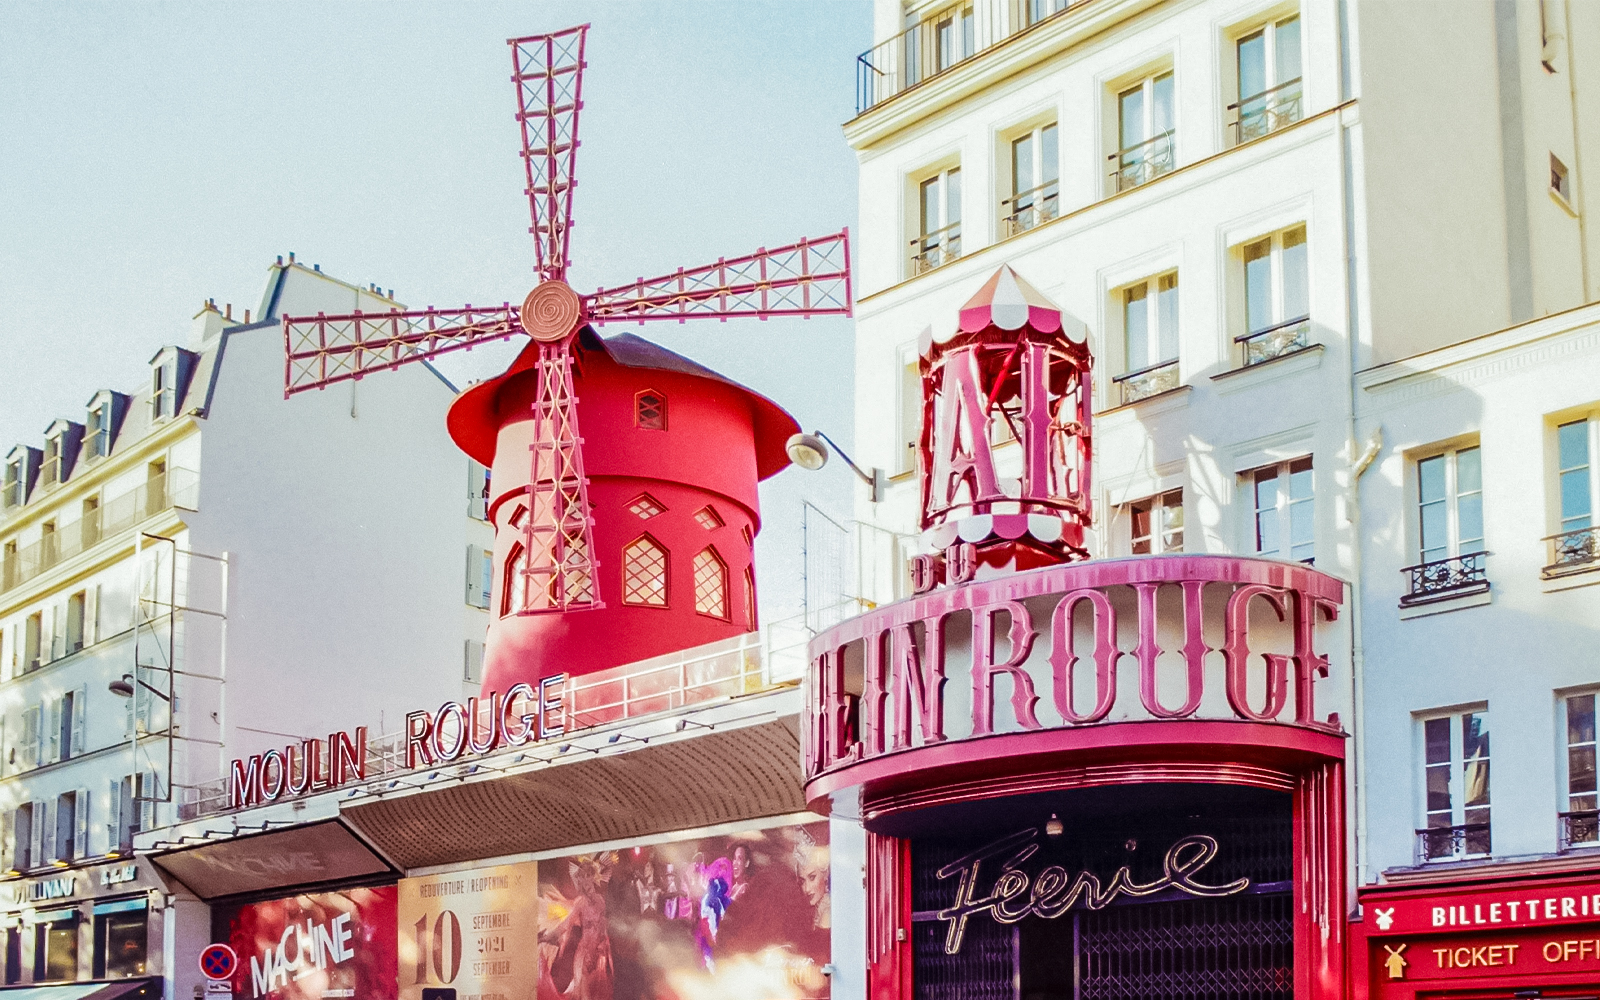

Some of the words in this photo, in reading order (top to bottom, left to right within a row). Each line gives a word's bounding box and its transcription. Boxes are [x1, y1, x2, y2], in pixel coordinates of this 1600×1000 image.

[911, 542, 977, 594] DU
[969, 580, 1346, 736] ROUGE
[230, 726, 367, 808] MOULIN
[405, 672, 570, 770] ROUGE
[473, 913, 510, 930] SEPTEMBRE
[1432, 893, 1600, 927] BILLETTERIE
[251, 911, 354, 998] MACHINE
[414, 909, 463, 985] 10
[477, 936, 505, 953] 2021
[1433, 944, 1519, 968] TICKET
[473, 960, 511, 976] SEPTEMBER
